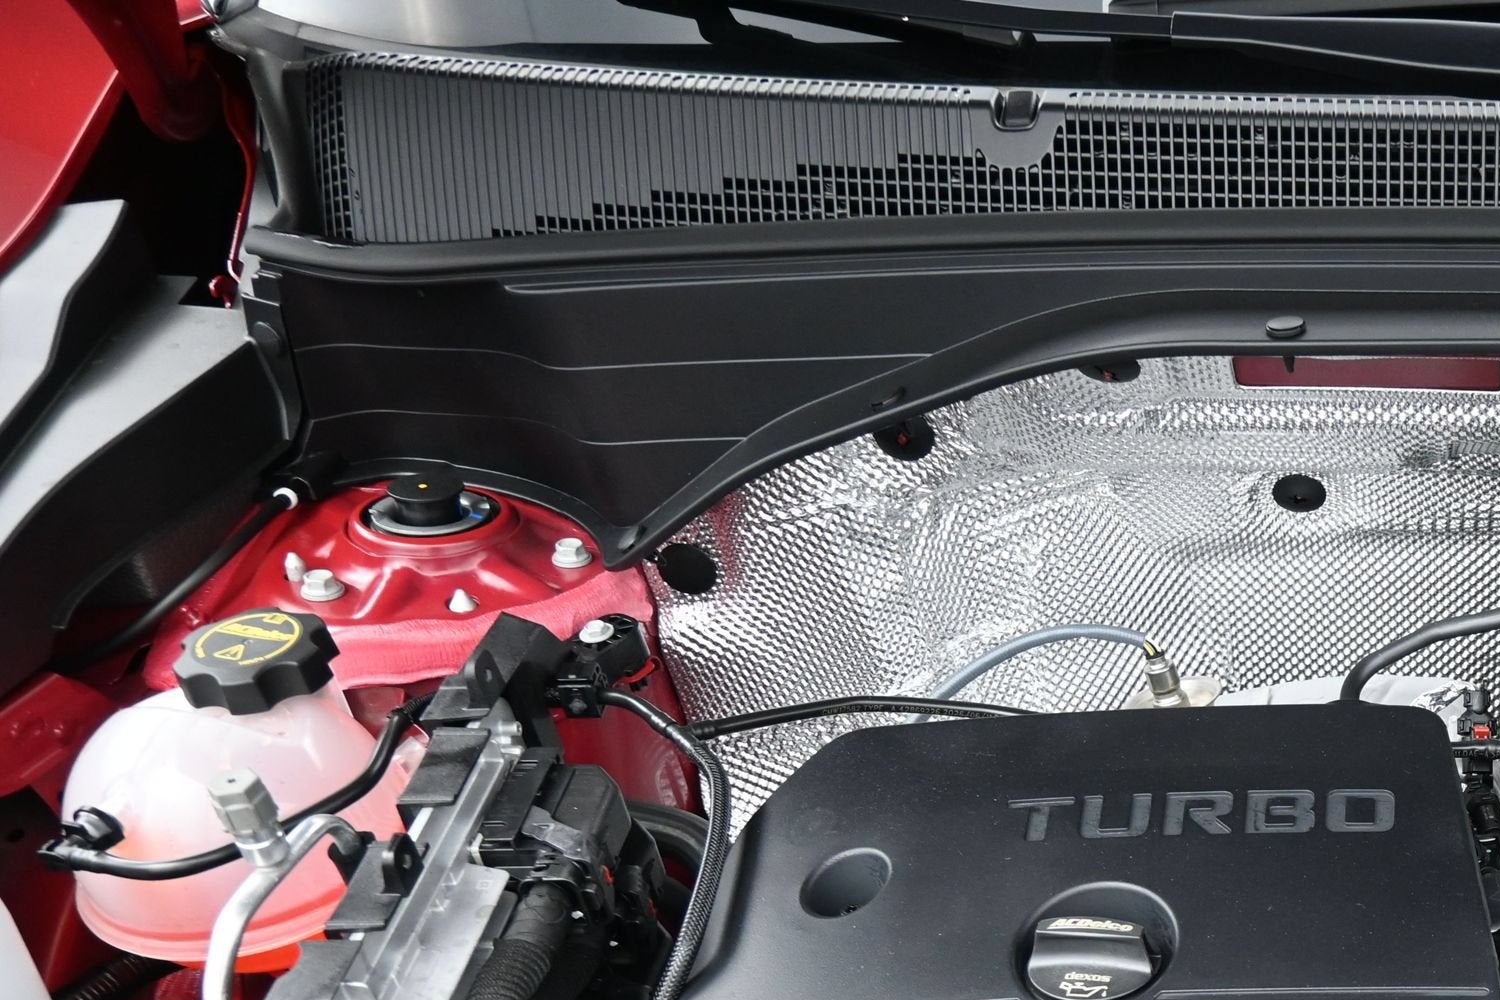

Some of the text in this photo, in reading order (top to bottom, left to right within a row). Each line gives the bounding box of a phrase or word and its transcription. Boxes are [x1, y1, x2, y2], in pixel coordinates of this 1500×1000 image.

[1007, 789, 1395, 841] TURBO
[1047, 918, 1133, 931] ACDelco
[1064, 971, 1112, 983] dexos
